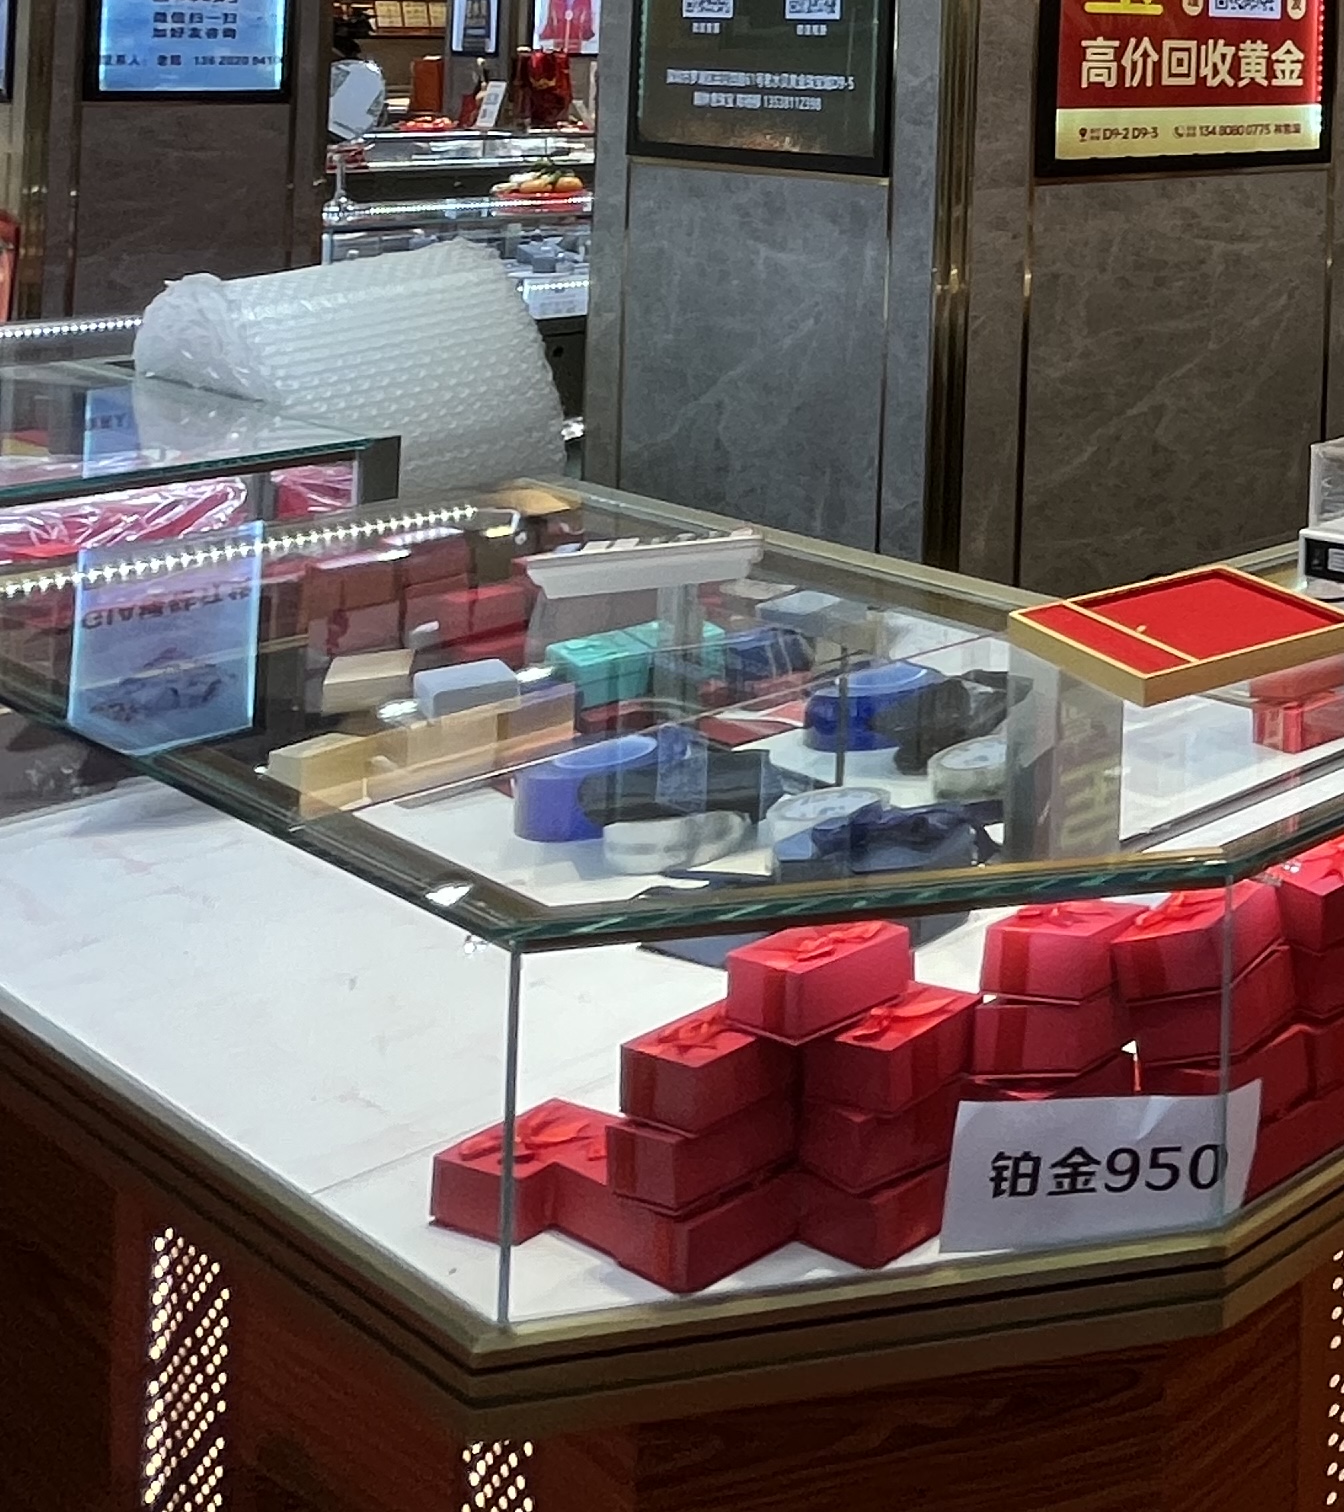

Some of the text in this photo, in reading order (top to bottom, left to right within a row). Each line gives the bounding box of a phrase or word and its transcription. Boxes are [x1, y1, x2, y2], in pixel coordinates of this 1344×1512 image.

[1080, 37, 1304, 88] 高价回收黄金
[989, 1144, 1228, 1199] 铂金950
